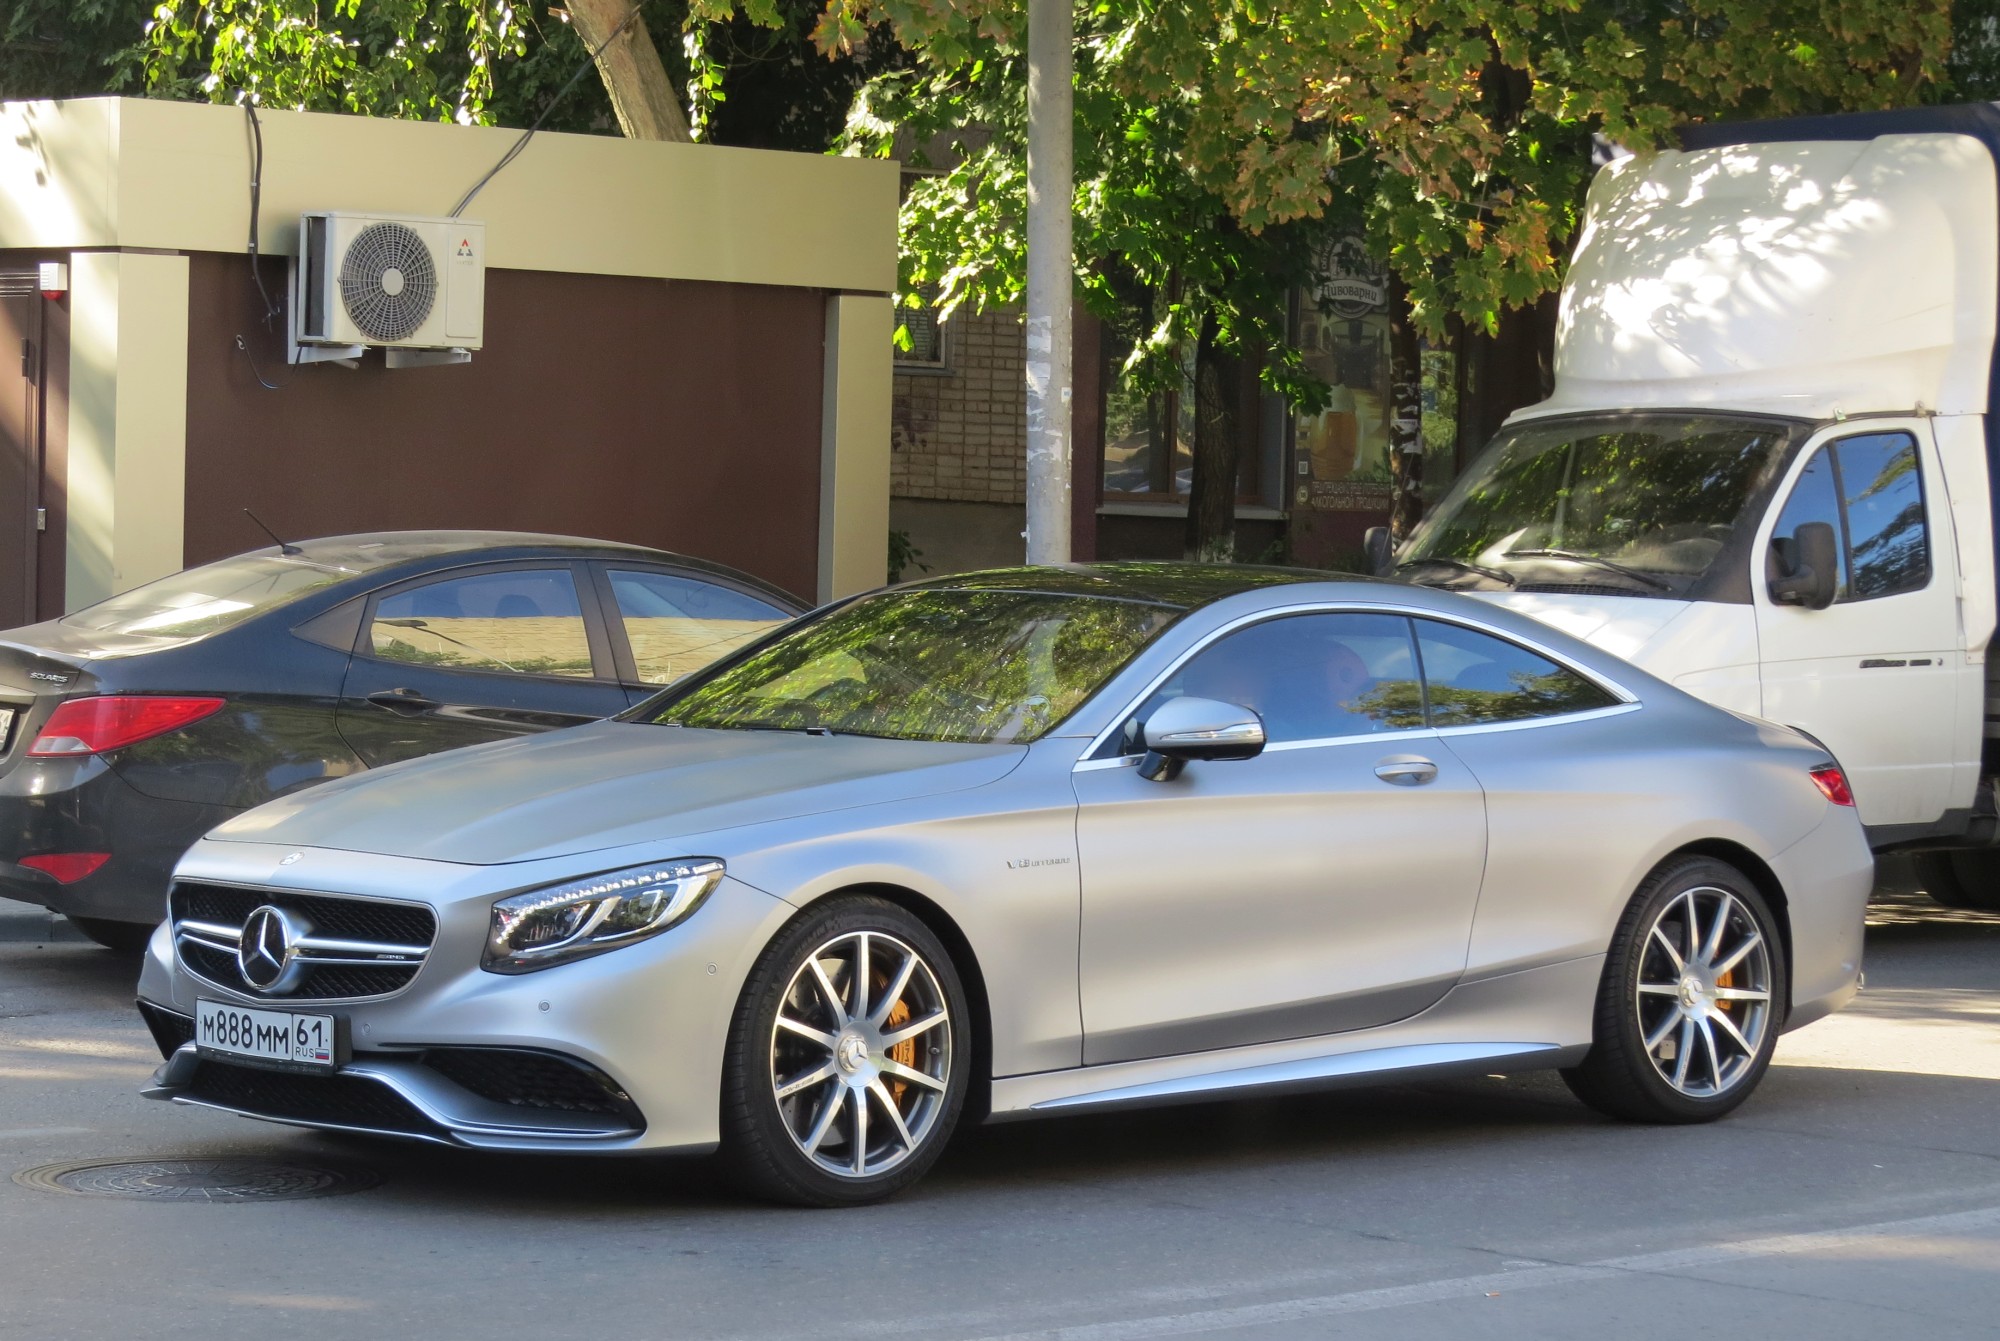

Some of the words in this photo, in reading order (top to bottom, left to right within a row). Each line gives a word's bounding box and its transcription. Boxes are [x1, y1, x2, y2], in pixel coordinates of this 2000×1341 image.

[30, 671, 68, 683] SOLARIS
[203, 1010, 289, 1054] M888MM
[296, 1018, 323, 1048] 61
[295, 1046, 315, 1059] RUS
